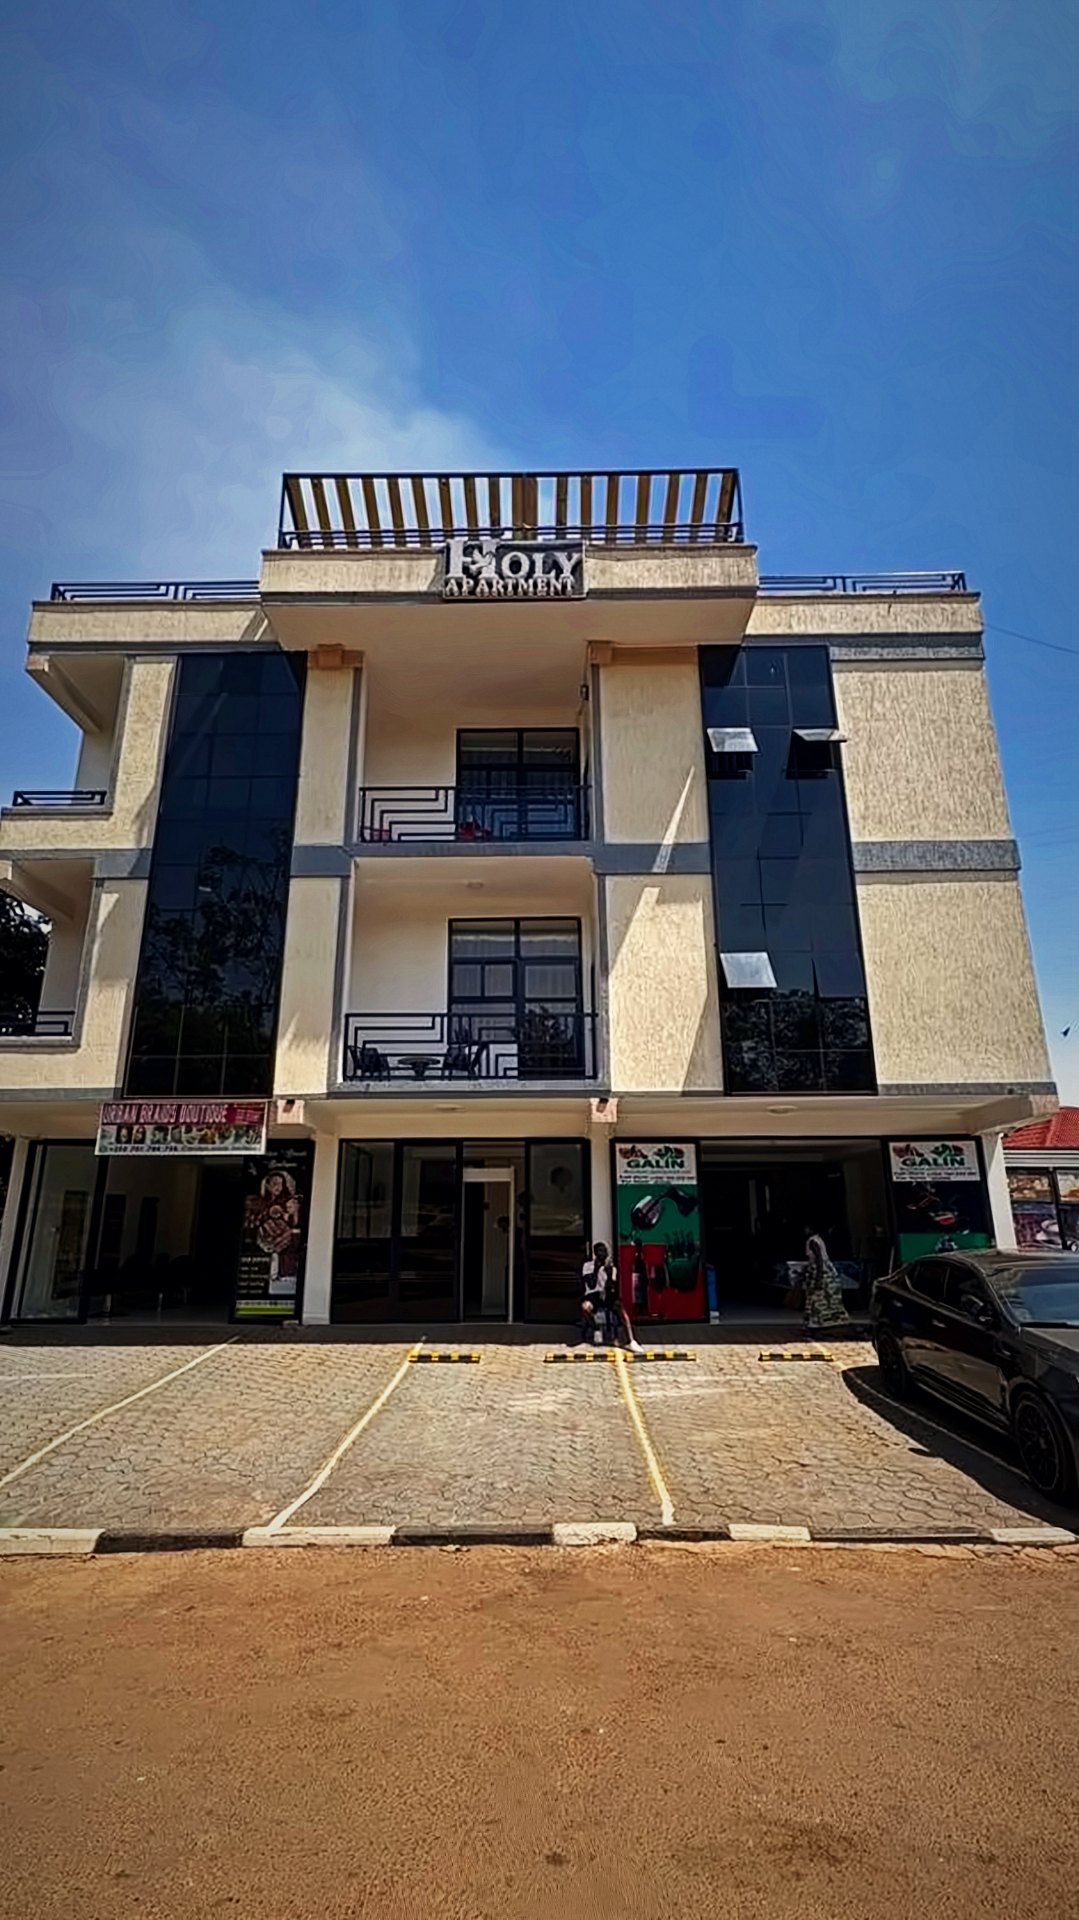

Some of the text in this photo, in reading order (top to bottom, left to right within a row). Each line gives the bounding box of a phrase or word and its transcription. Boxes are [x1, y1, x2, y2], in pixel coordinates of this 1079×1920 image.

[445, 539, 580, 577] HOLY
[445, 578, 576, 596] APARTMENT
[103, 1104, 139, 1123] URBAN
[139, 1104, 177, 1123] BRAIDS
[179, 1104, 228, 1123] BOUTIQUE
[627, 1159, 685, 1169] GALIN
[901, 1157, 965, 1167] GALIN
